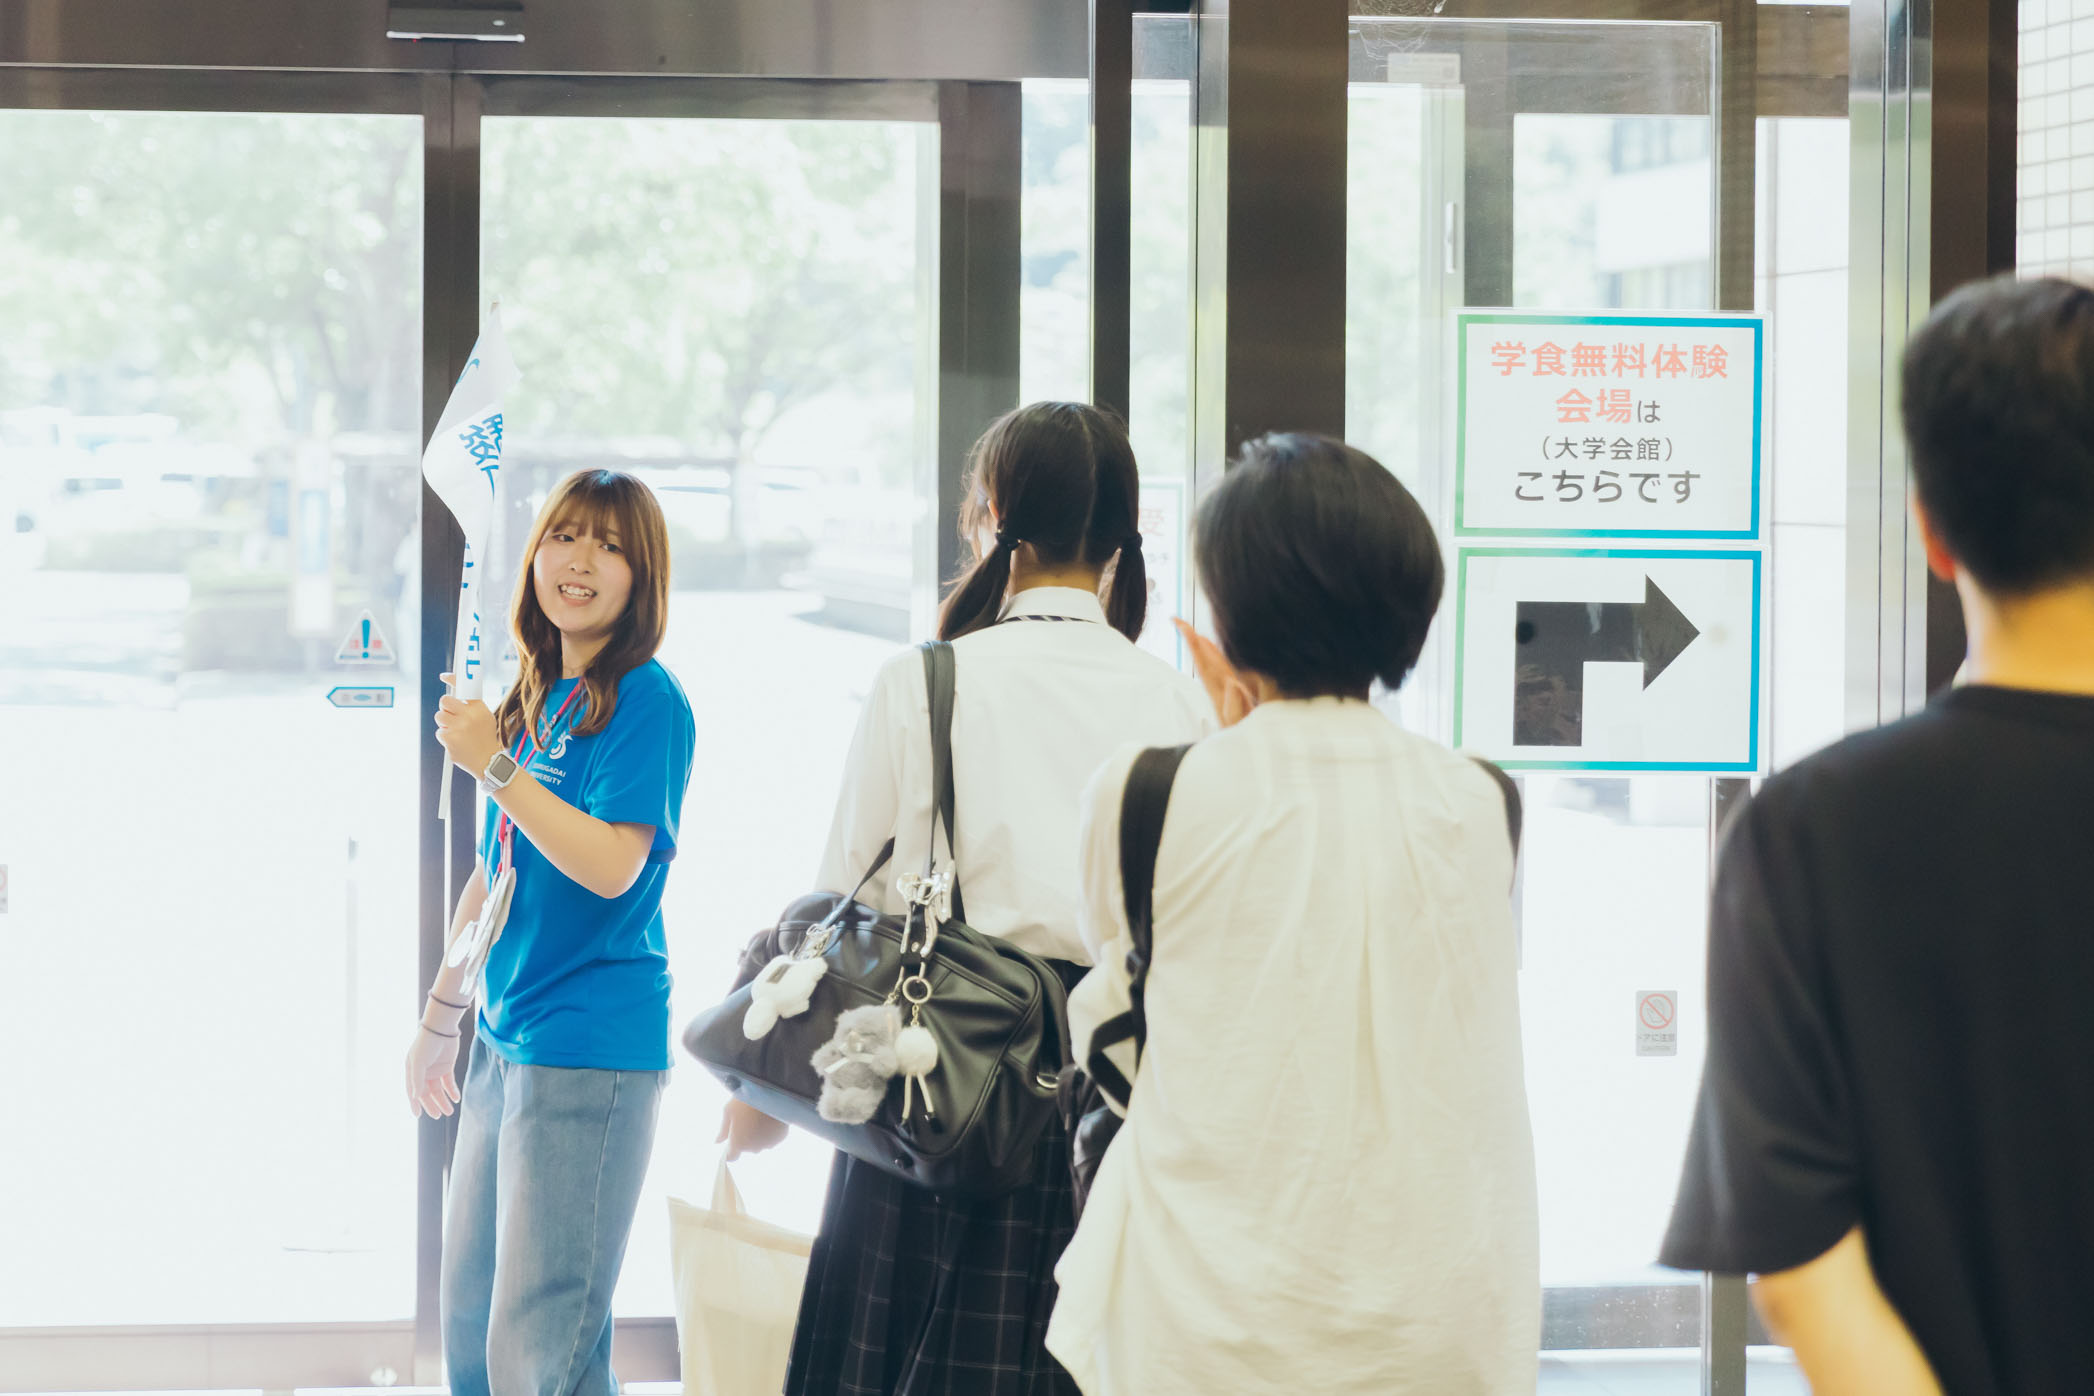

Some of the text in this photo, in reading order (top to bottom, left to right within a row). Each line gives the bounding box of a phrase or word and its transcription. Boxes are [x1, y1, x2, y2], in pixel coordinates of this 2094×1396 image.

[1491, 341, 1728, 379] 学食無料体験
[1556, 388, 1661, 423] 会場は
[1543, 435, 1673, 462] （大学会館）
[1515, 470, 1701, 503] こちらです
